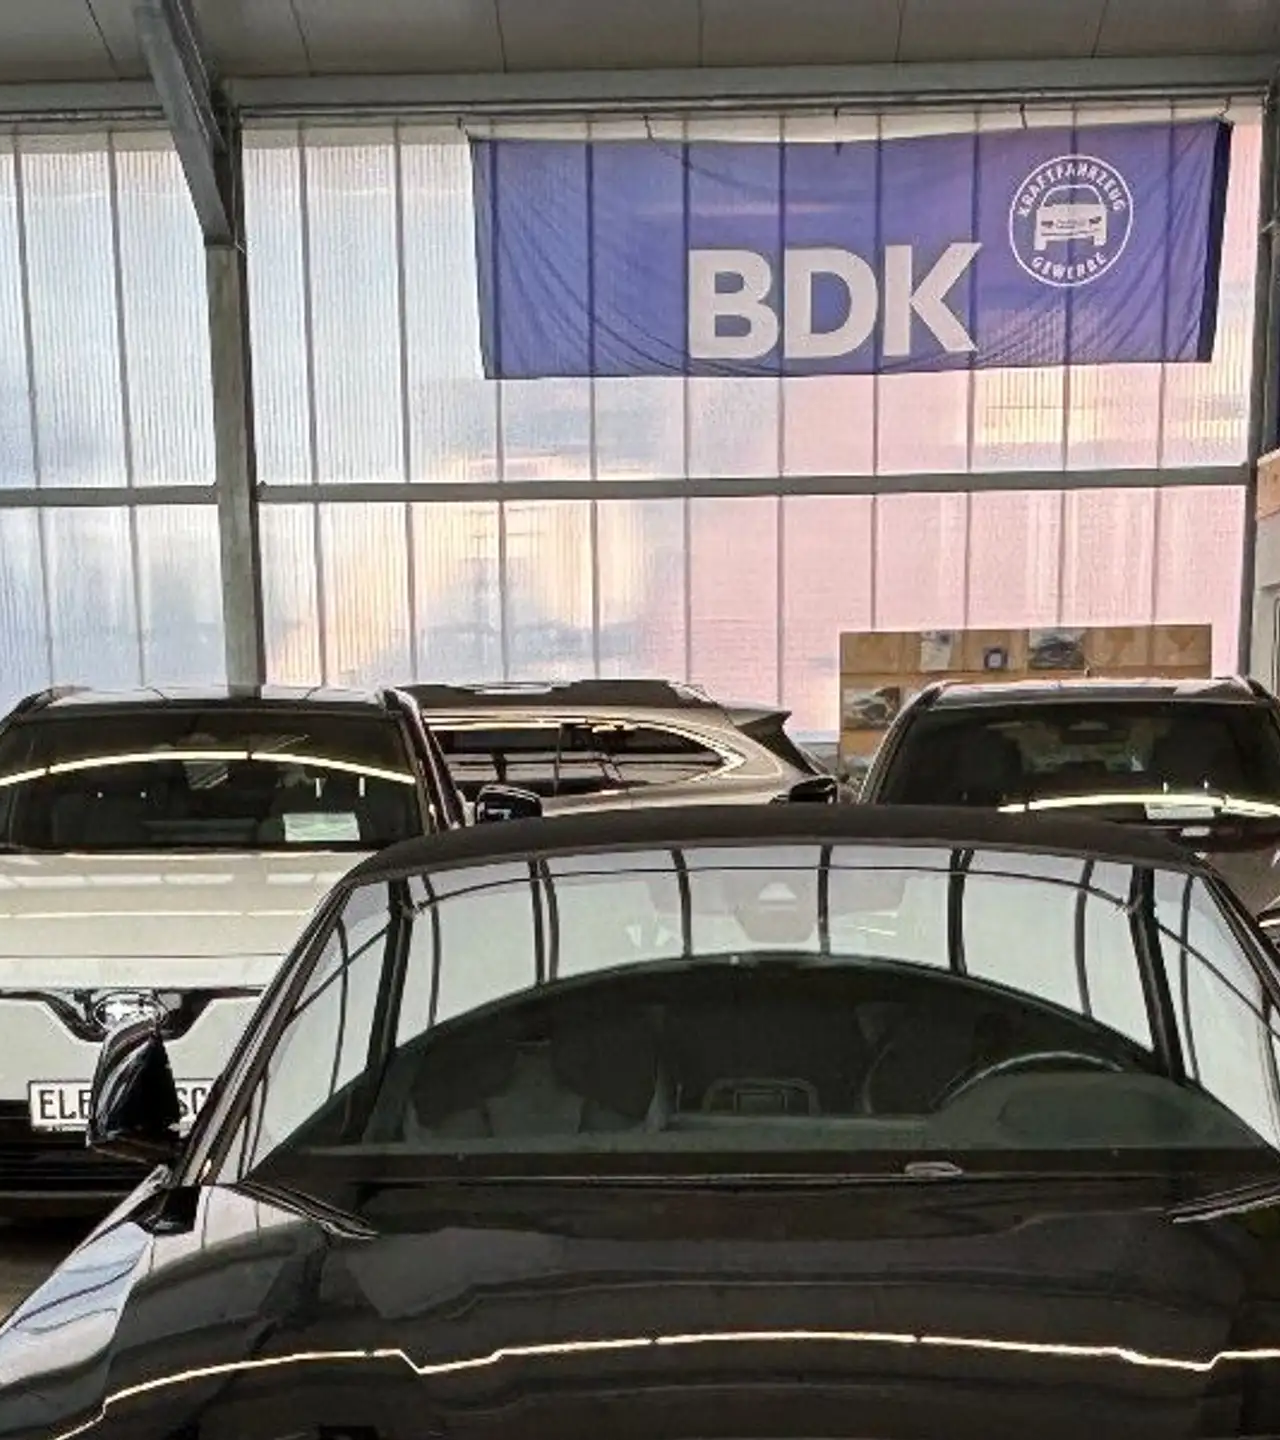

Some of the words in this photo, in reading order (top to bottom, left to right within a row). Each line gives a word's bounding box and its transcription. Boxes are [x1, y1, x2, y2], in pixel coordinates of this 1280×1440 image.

[1017, 162, 1127, 217] KRAFTFAHRZEUG
[1032, 251, 1108, 280] GEWERBE
[688, 242, 983, 359] BDK
